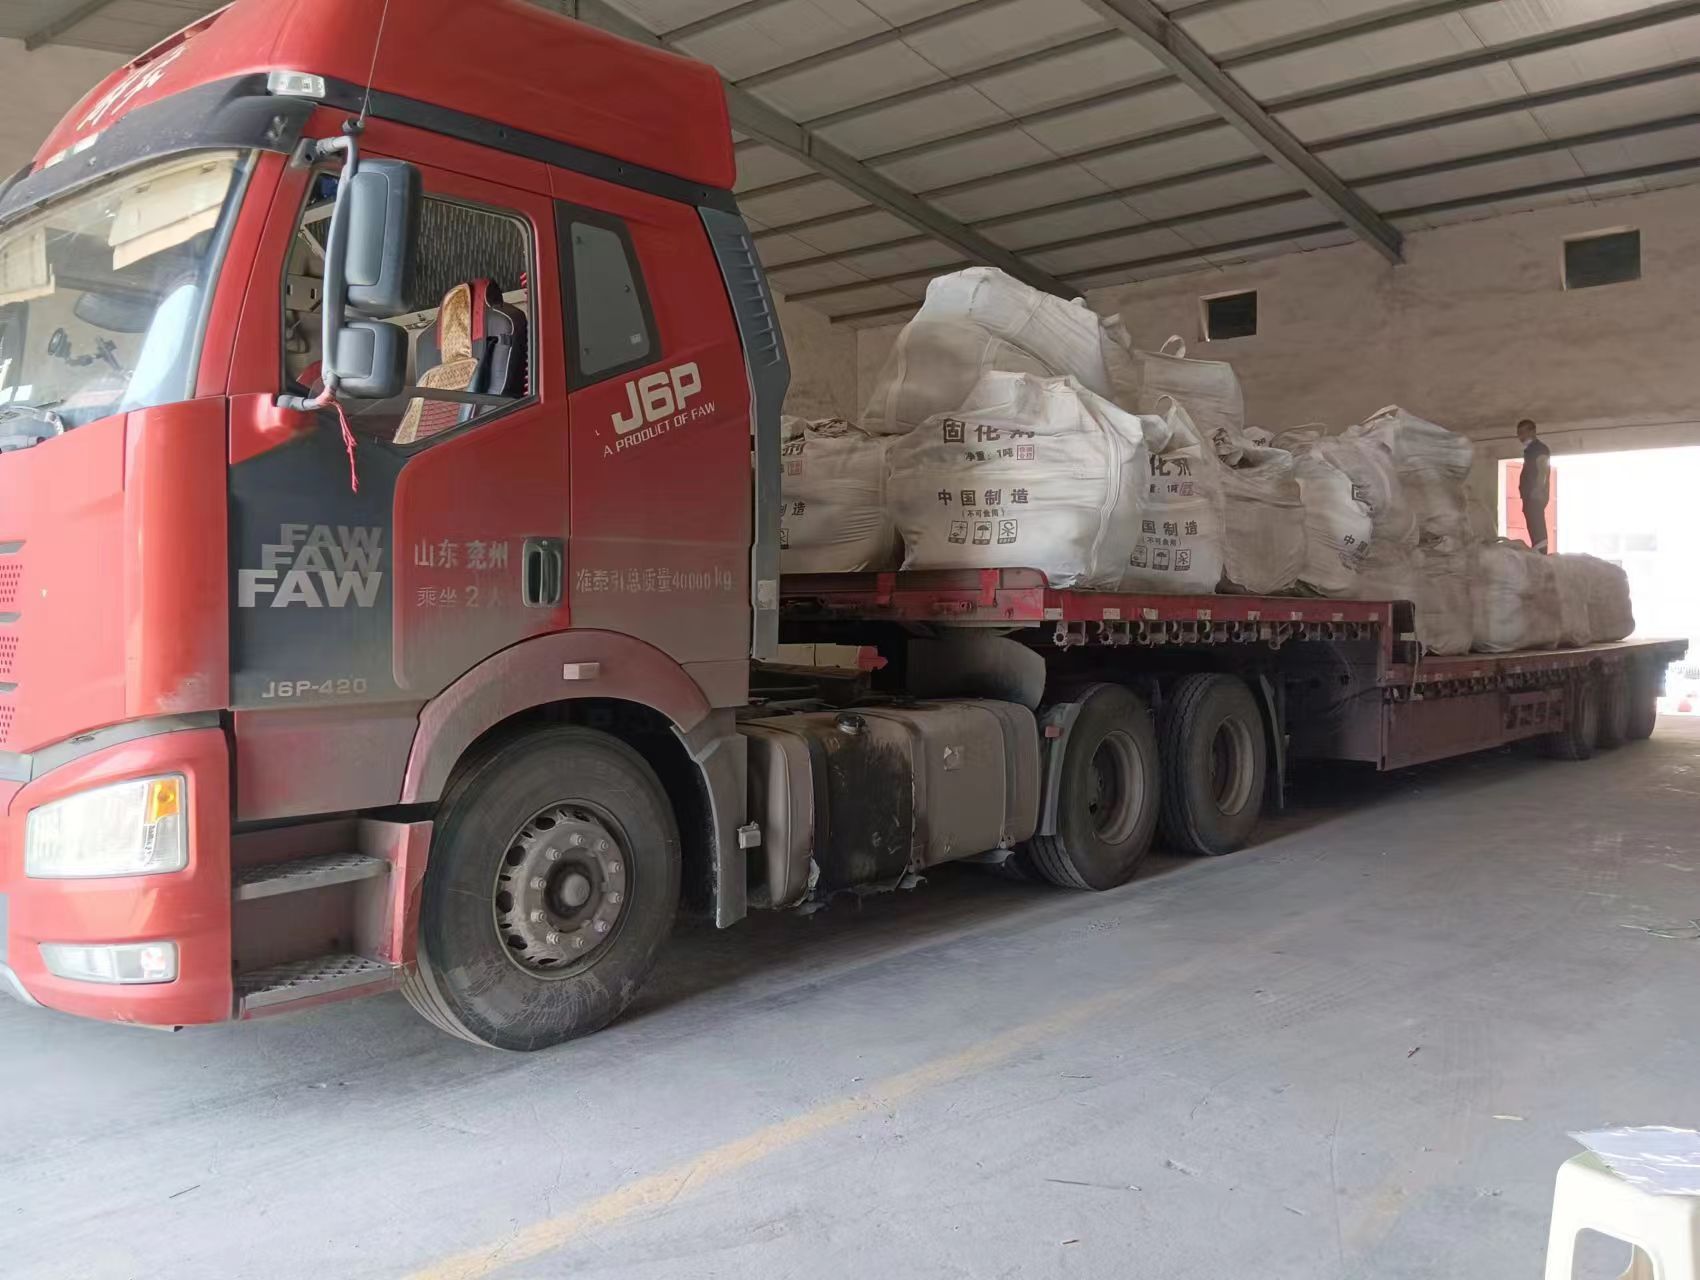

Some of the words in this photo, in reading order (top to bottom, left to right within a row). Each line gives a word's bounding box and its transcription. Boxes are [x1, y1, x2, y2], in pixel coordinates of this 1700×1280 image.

[611, 361, 702, 435] J6P
[603, 445, 613, 458] A
[615, 420, 671, 452] PRODUCT
[673, 413, 689, 428] OF
[691, 401, 716, 421] FAW
[938, 488, 1029, 506] 中国制造
[238, 569, 383, 608] FAW
[261, 678, 368, 698] J6P-420
